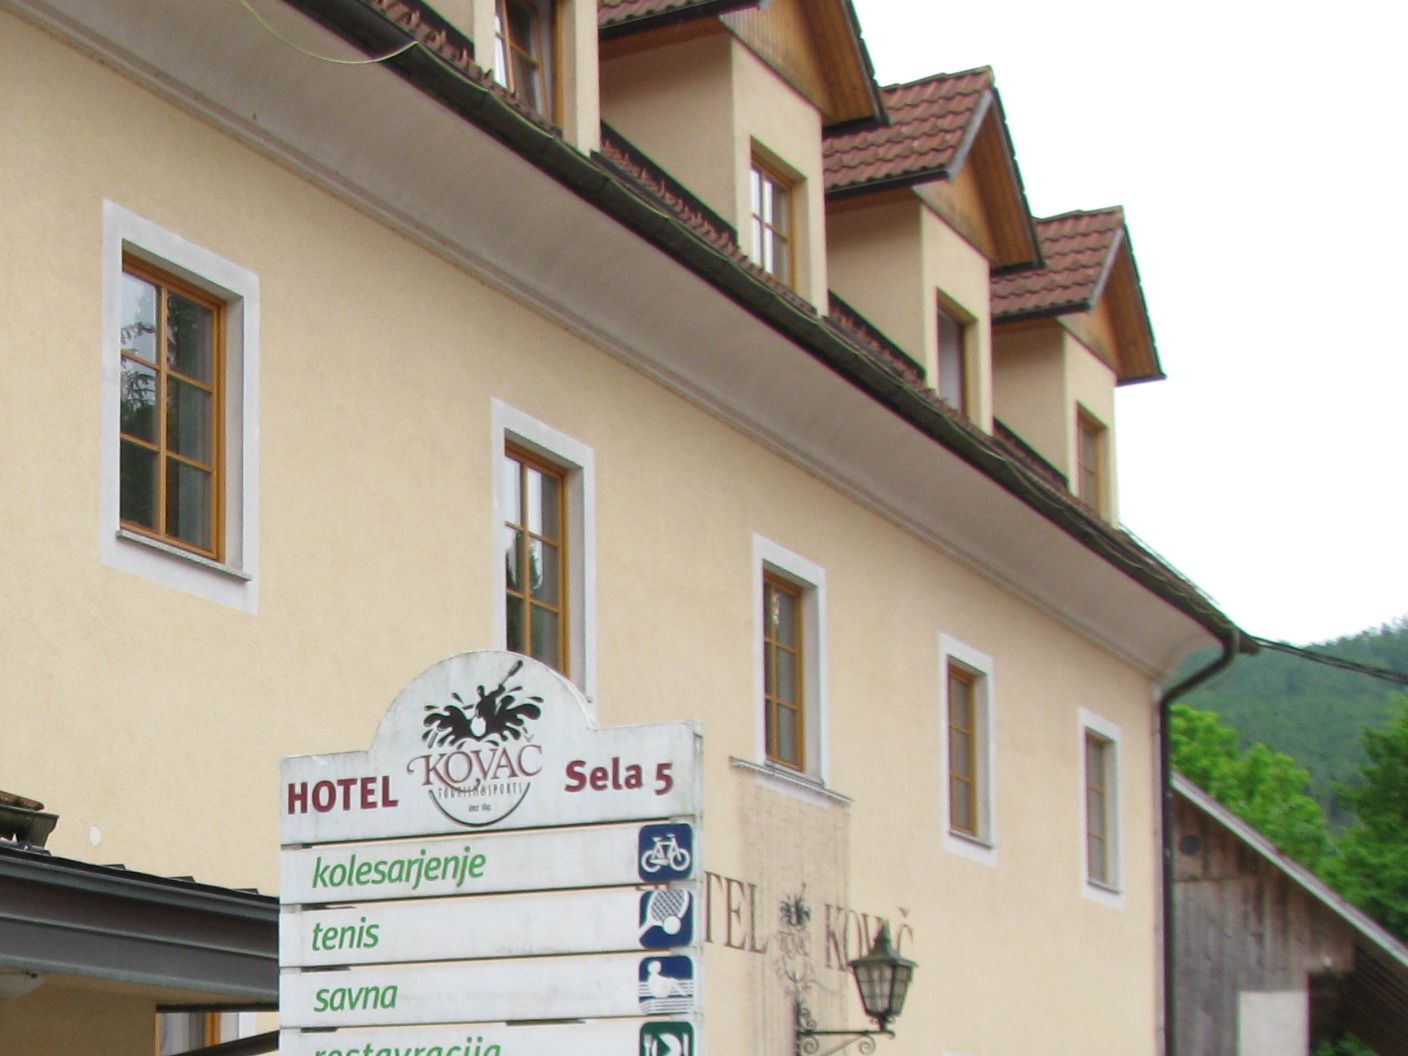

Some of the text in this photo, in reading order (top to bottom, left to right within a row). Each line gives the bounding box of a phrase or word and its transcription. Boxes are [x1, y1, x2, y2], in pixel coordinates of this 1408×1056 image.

[406, 734, 543, 793] KOVAČ
[564, 757, 674, 795] Sela 5
[287, 775, 399, 815] HOTEL
[312, 846, 486, 890] kolesarjenje
[703, 870, 768, 954] TEL
[311, 917, 380, 951] tenis
[313, 984, 398, 1012] savna
